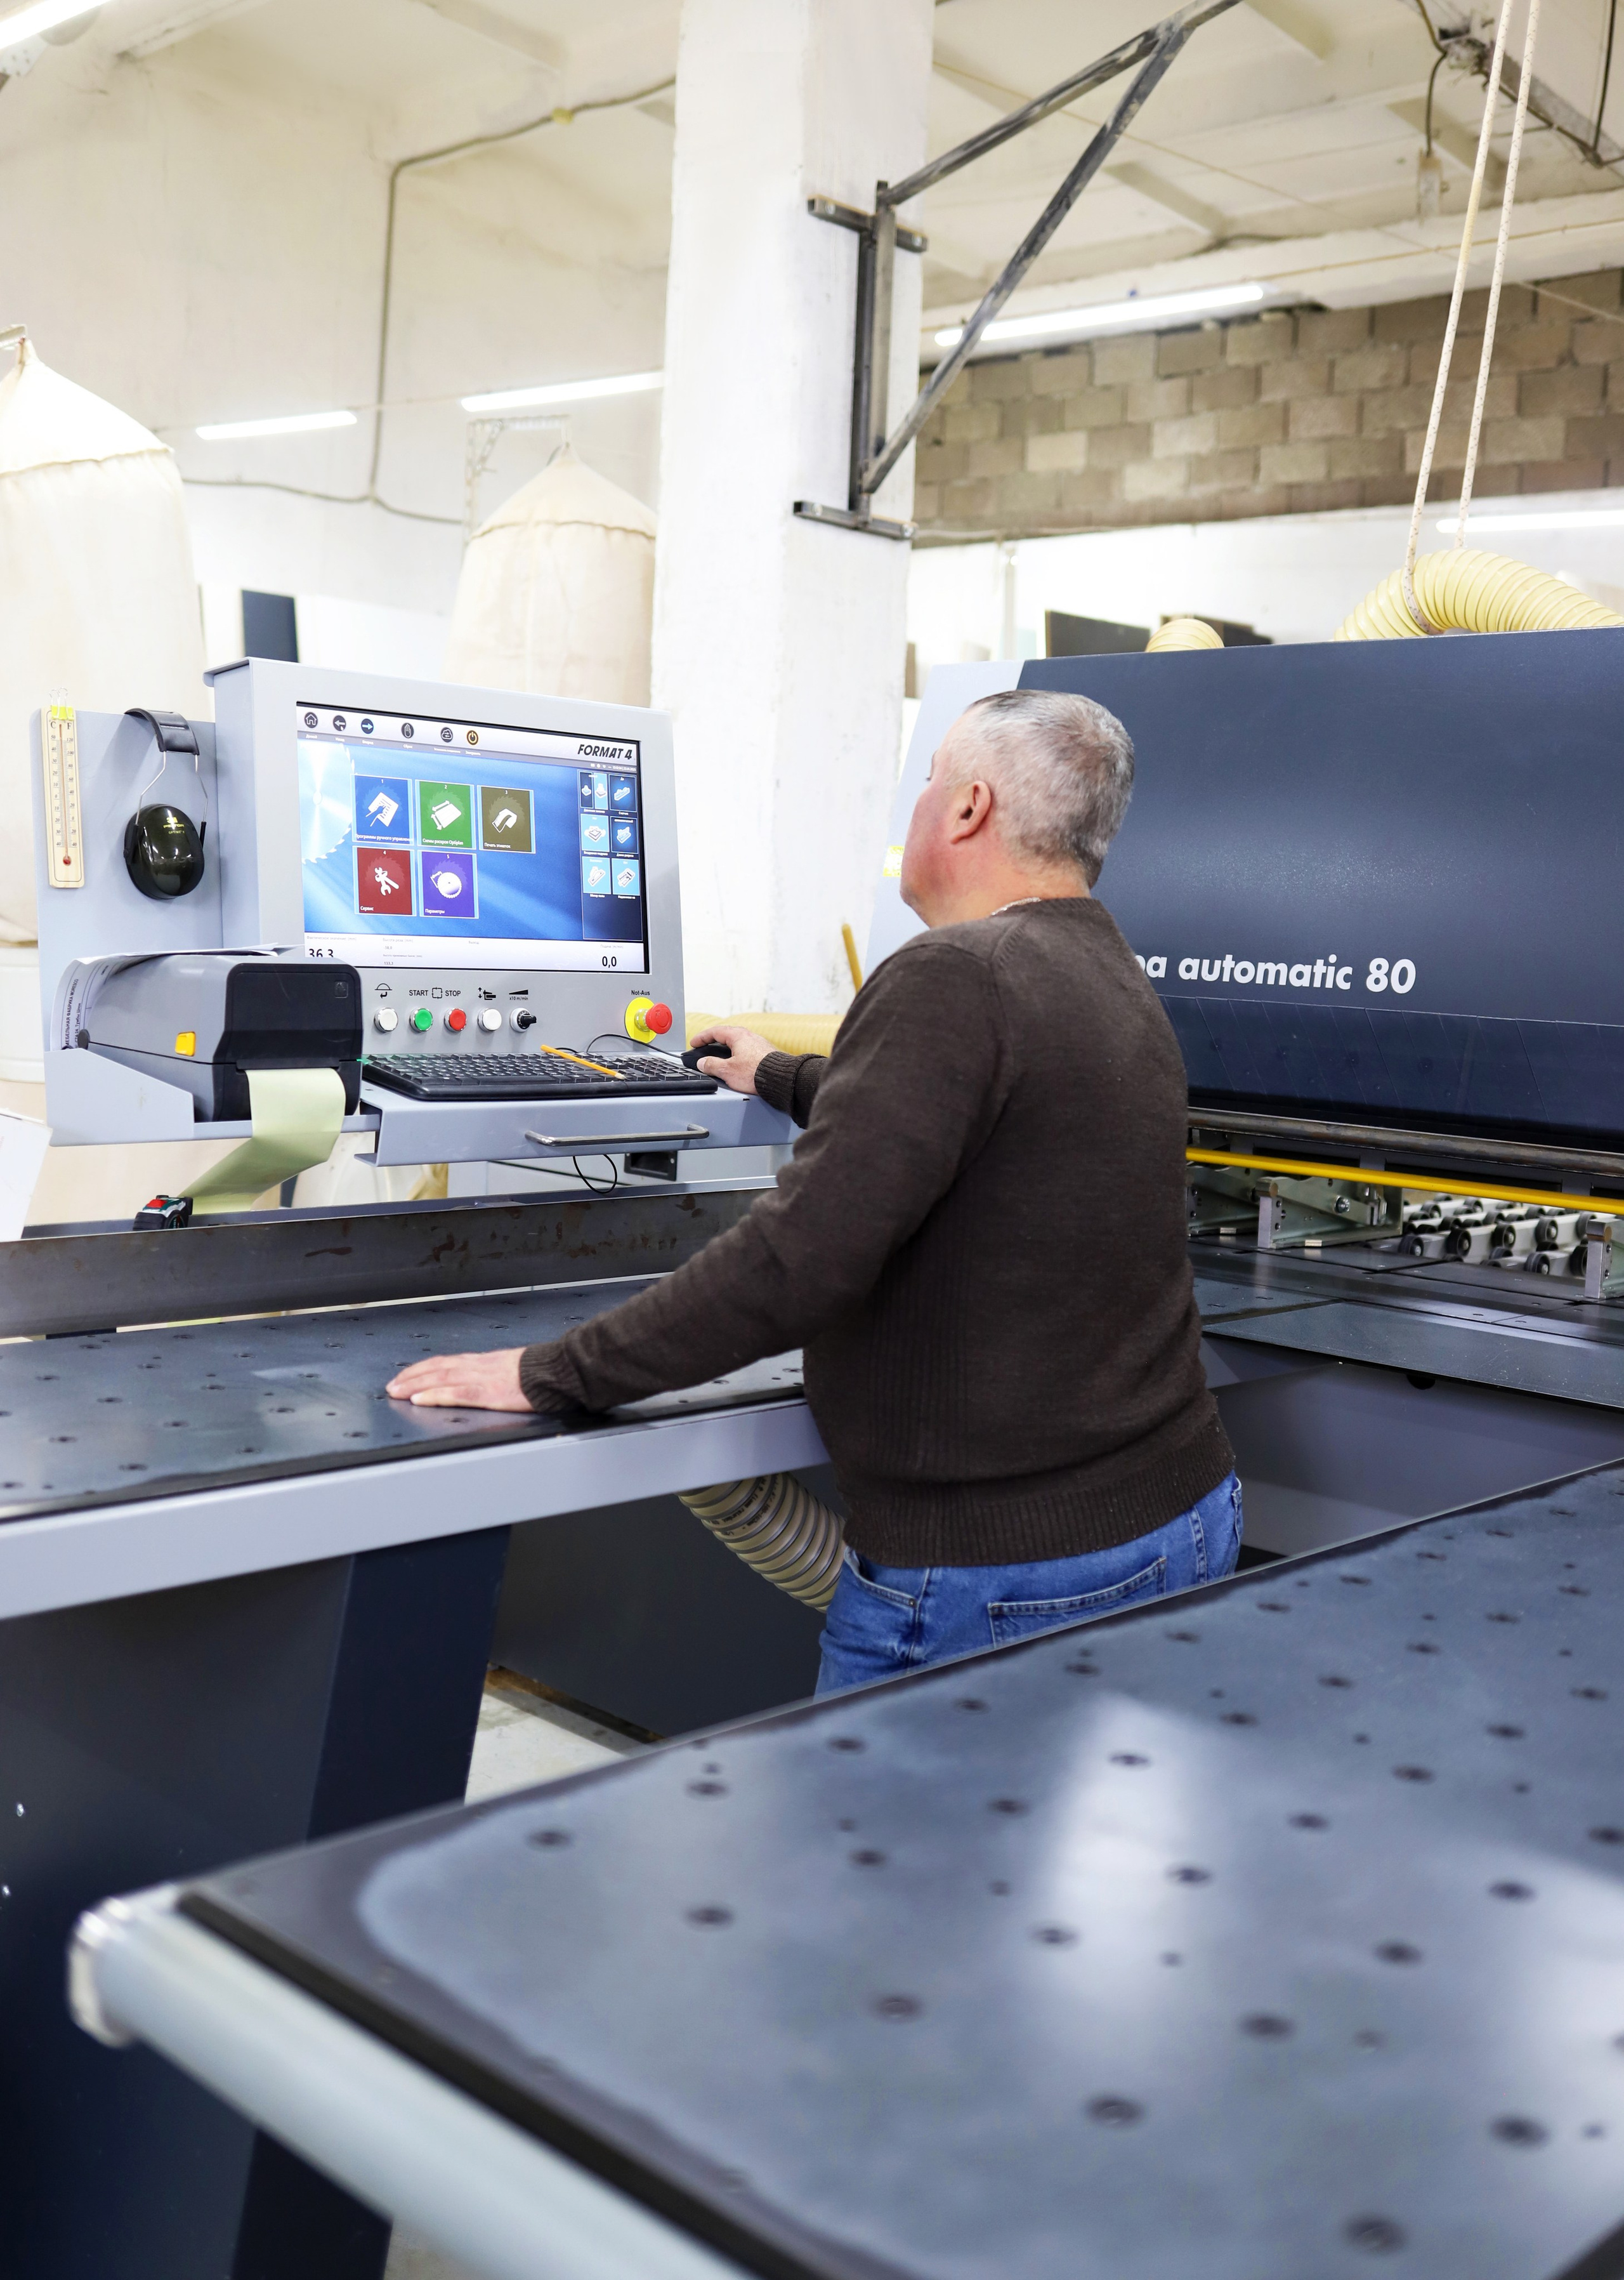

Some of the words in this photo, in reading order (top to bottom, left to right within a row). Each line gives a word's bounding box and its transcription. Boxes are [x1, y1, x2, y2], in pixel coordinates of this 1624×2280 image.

[577, 744, 624, 759] FORMAT
[624, 749, 632, 760] 4
[602, 956, 617, 968] 0,0
[1178, 954, 1353, 991] automatic
[1366, 958, 1416, 994] 80
